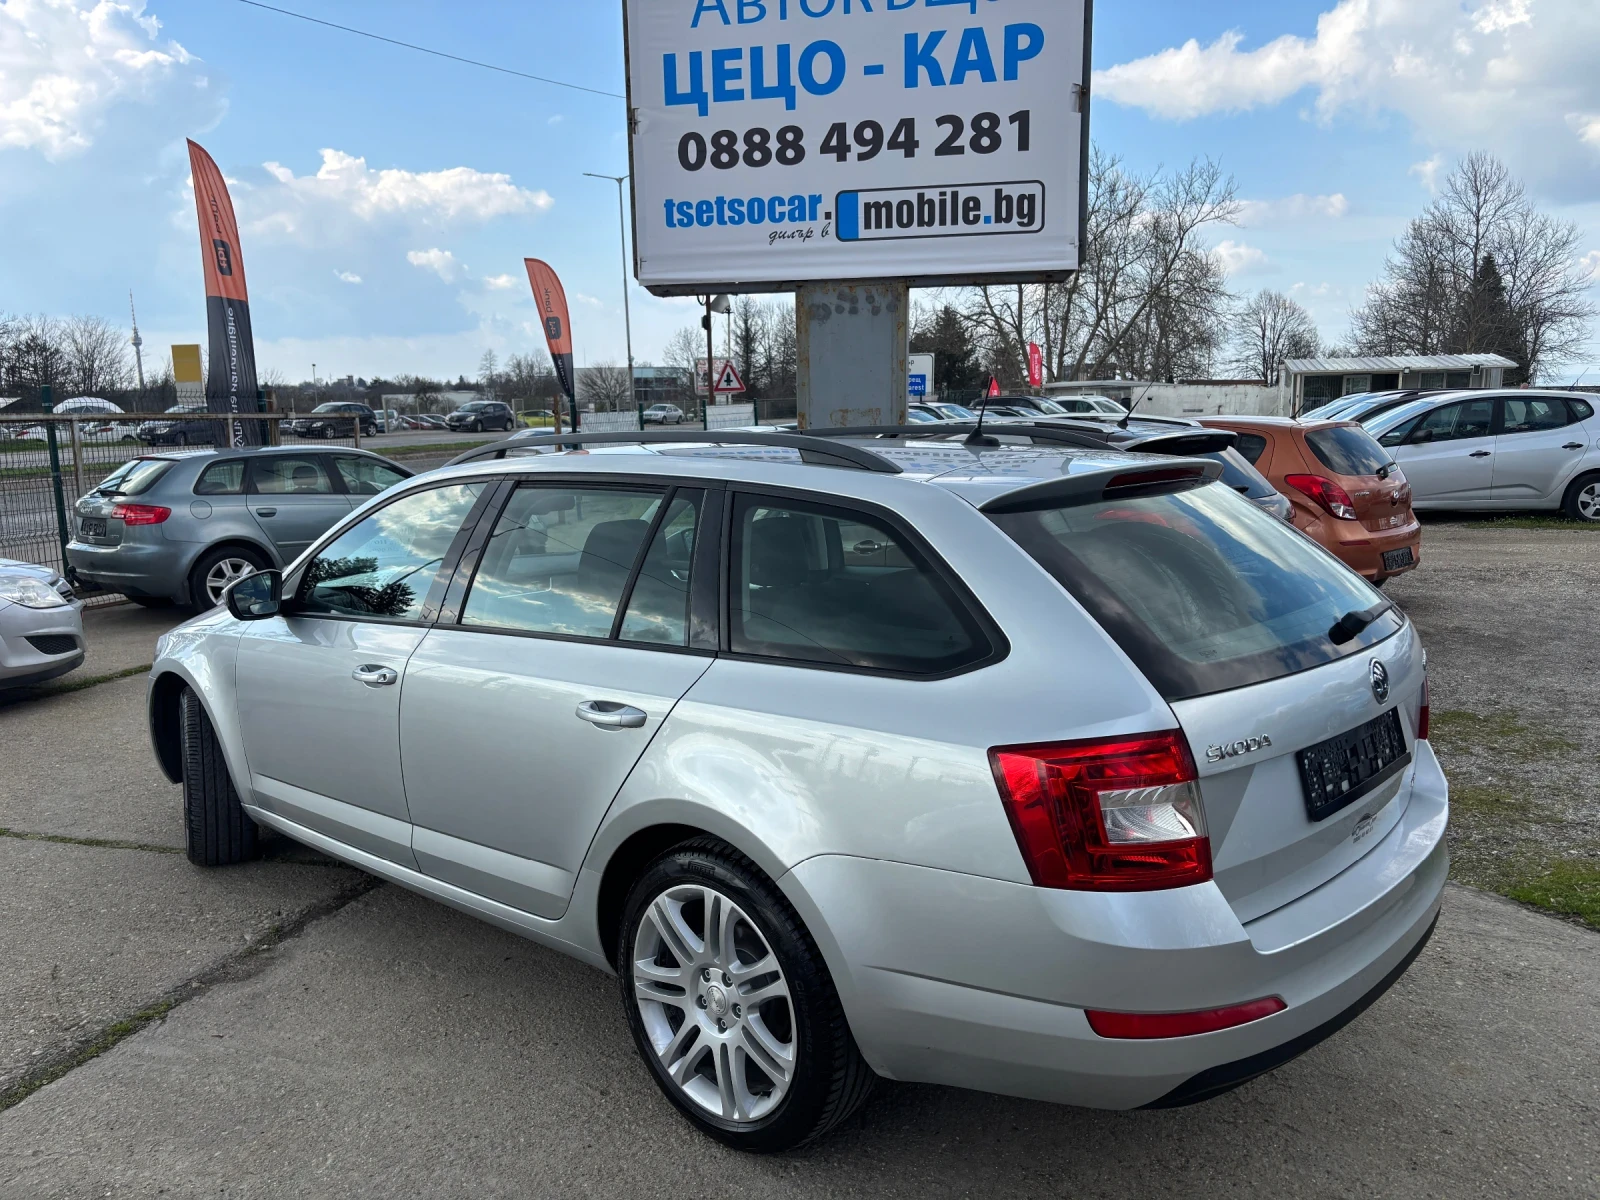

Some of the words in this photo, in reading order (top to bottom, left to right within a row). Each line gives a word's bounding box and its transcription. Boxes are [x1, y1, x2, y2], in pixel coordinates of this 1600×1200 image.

[663, 39, 846, 117] ЦЕЦО
[863, 64, 884, 76] -
[904, 22, 1045, 89] КАР
[678, 124, 806, 172] 0888
[819, 117, 920, 162] 494
[934, 109, 1030, 157] 281
[863, 188, 1036, 230] mobile.bg
[768, 226, 815, 246] дилър
[820, 221, 831, 238] в
[1206, 733, 1272, 763] ŠKODA
